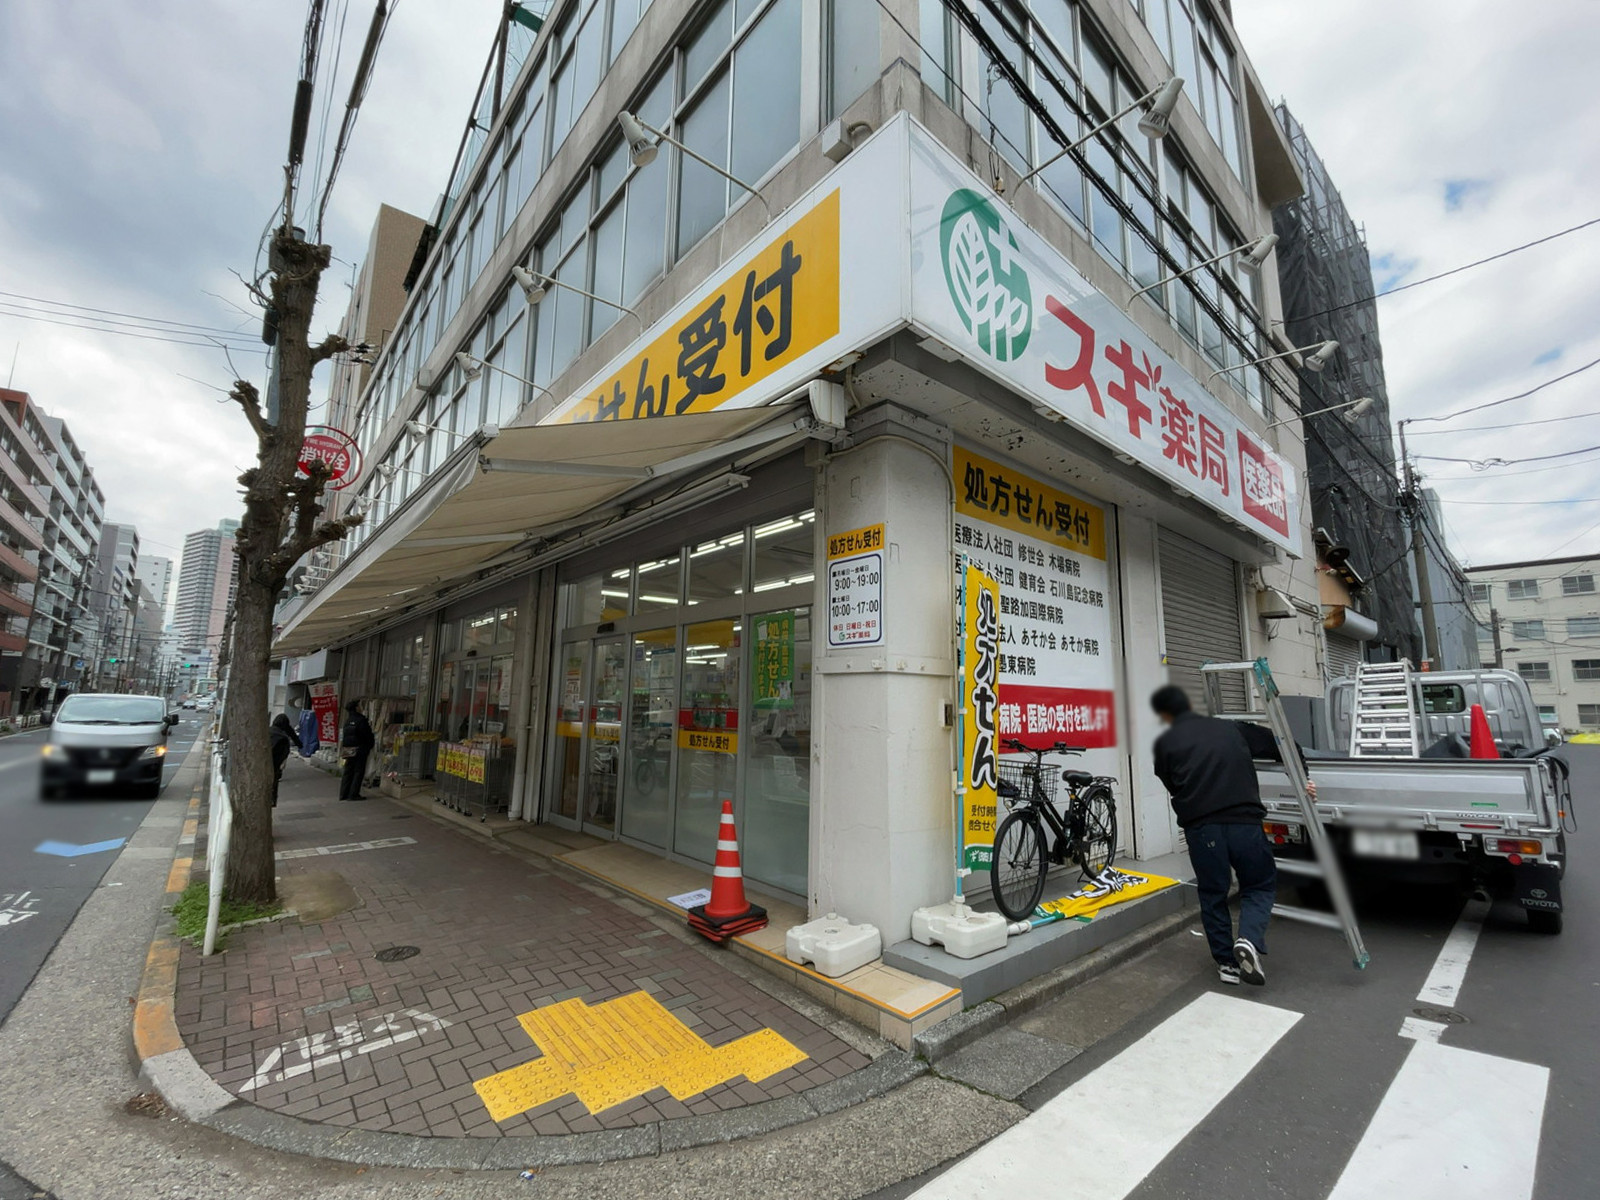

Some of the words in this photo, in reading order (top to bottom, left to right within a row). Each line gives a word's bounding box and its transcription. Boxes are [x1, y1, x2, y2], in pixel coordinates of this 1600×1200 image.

[572, 240, 802, 421] せん受付
[1045, 294, 1229, 498] スギ薬局
[964, 462, 1090, 546] 処方せん受付
[829, 527, 881, 556] 処方せん受付
[1049, 553, 1081, 578] 木場病院
[1049, 578, 1104, 608] 石川島記念病院
[1000, 594, 1064, 625] 聖路加国際病院
[1021, 628, 1056, 650] あそか会
[1061, 633, 1099, 656] あそか病院
[767, 621, 780, 698] 処方せん
[970, 582, 998, 790] 処方せん
[689, 734, 730, 750] 処方せん受付
[1520, 898, 1560, 909] TOYOTA
